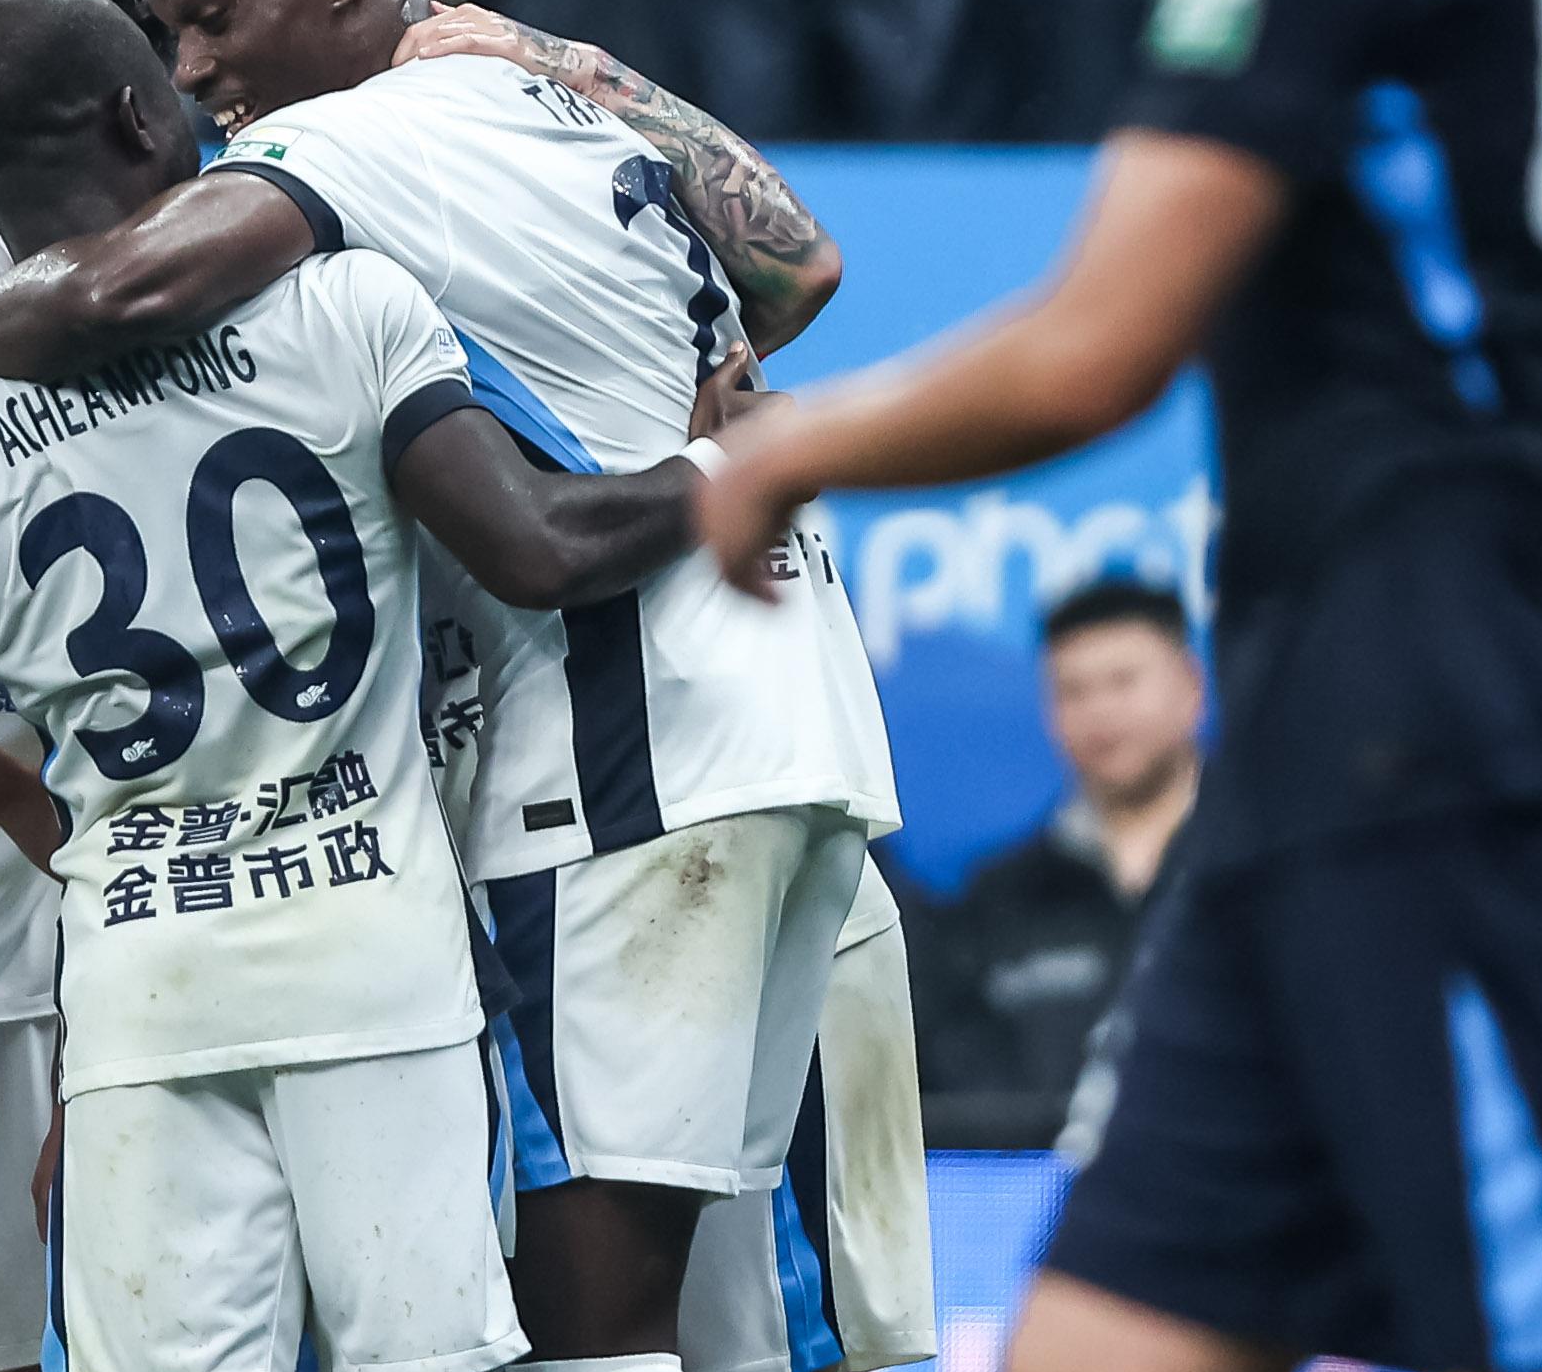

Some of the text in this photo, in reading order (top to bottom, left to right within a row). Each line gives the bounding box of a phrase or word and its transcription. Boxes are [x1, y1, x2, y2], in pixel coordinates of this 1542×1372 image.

[18, 425, 377, 781] 30
[103, 819, 396, 929] 金普市政
